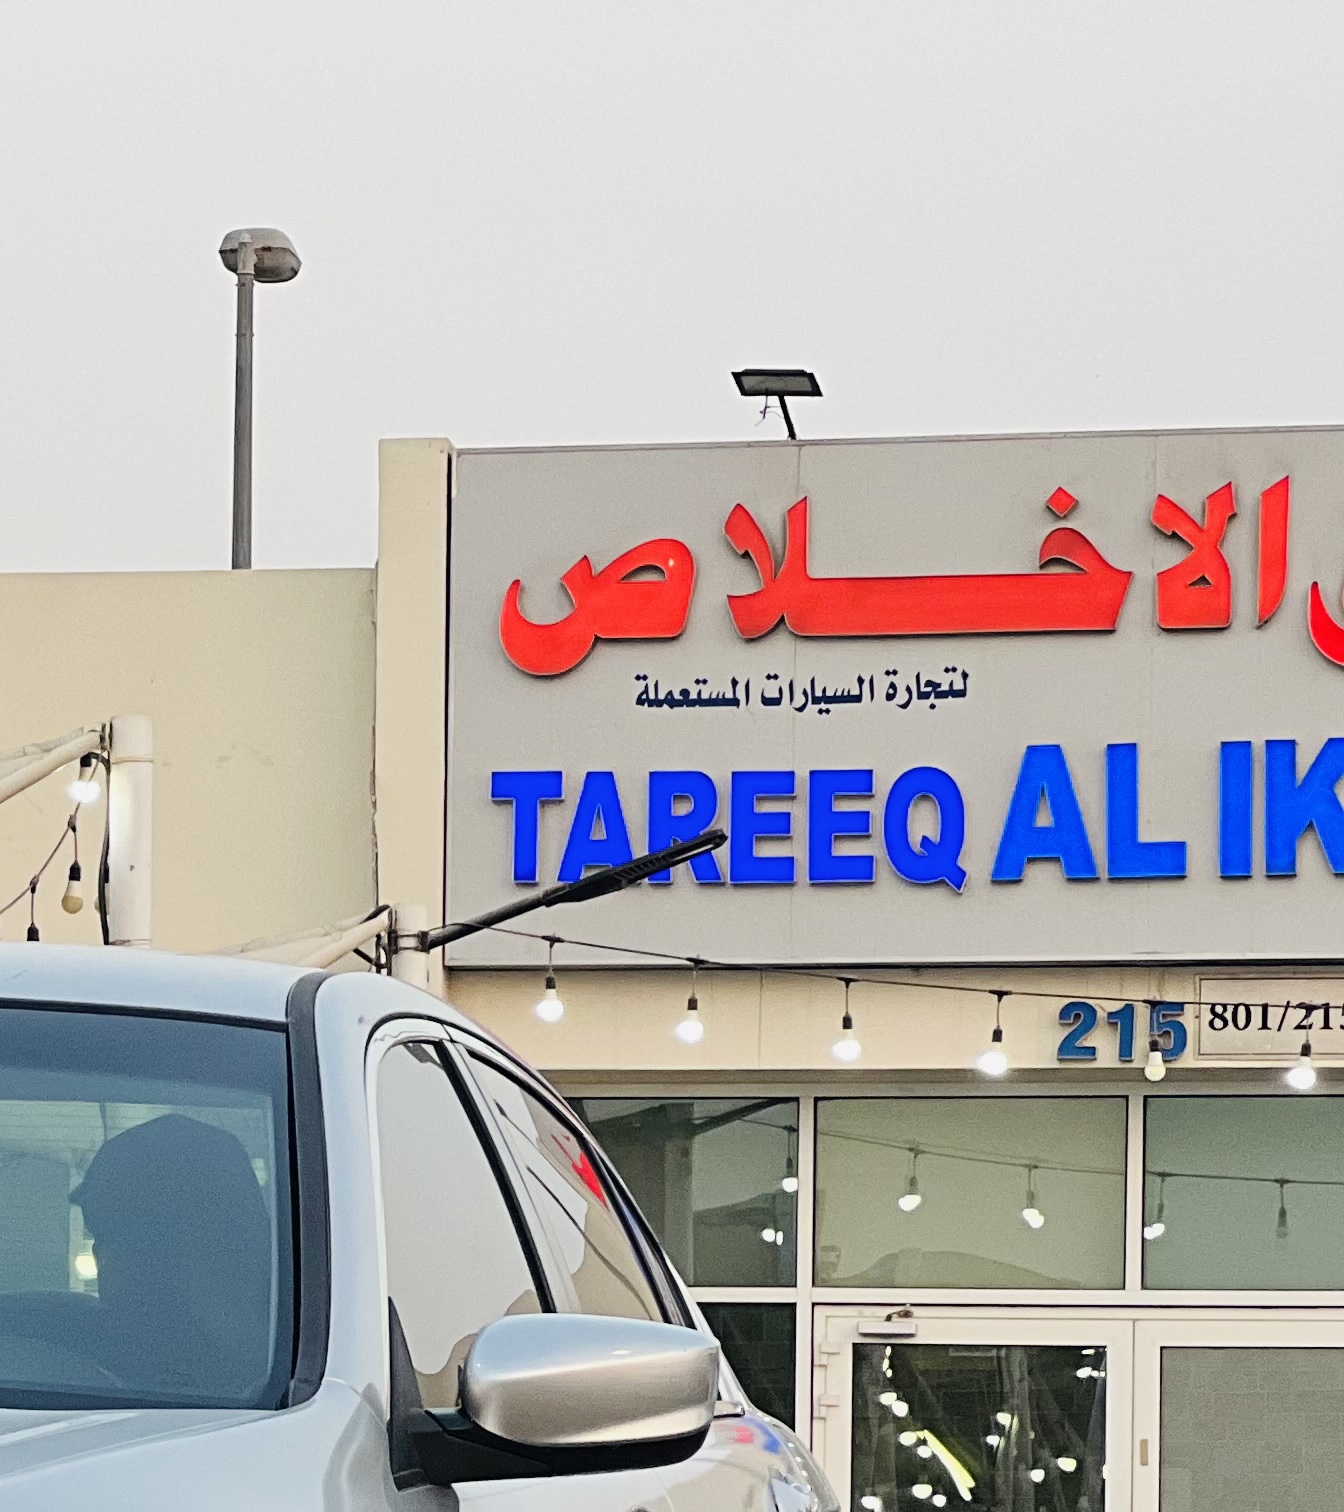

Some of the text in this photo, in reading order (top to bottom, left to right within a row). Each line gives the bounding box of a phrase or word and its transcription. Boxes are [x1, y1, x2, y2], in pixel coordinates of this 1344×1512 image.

[500, 475, 1289, 675] الاخلاص
[634, 666, 969, 715] لتجارة السيارات المستعملة
[491, 766, 968, 894] TAREEQ
[991, 743, 1188, 882] AL
[1056, 1000, 1344, 1062] 215 801/21
